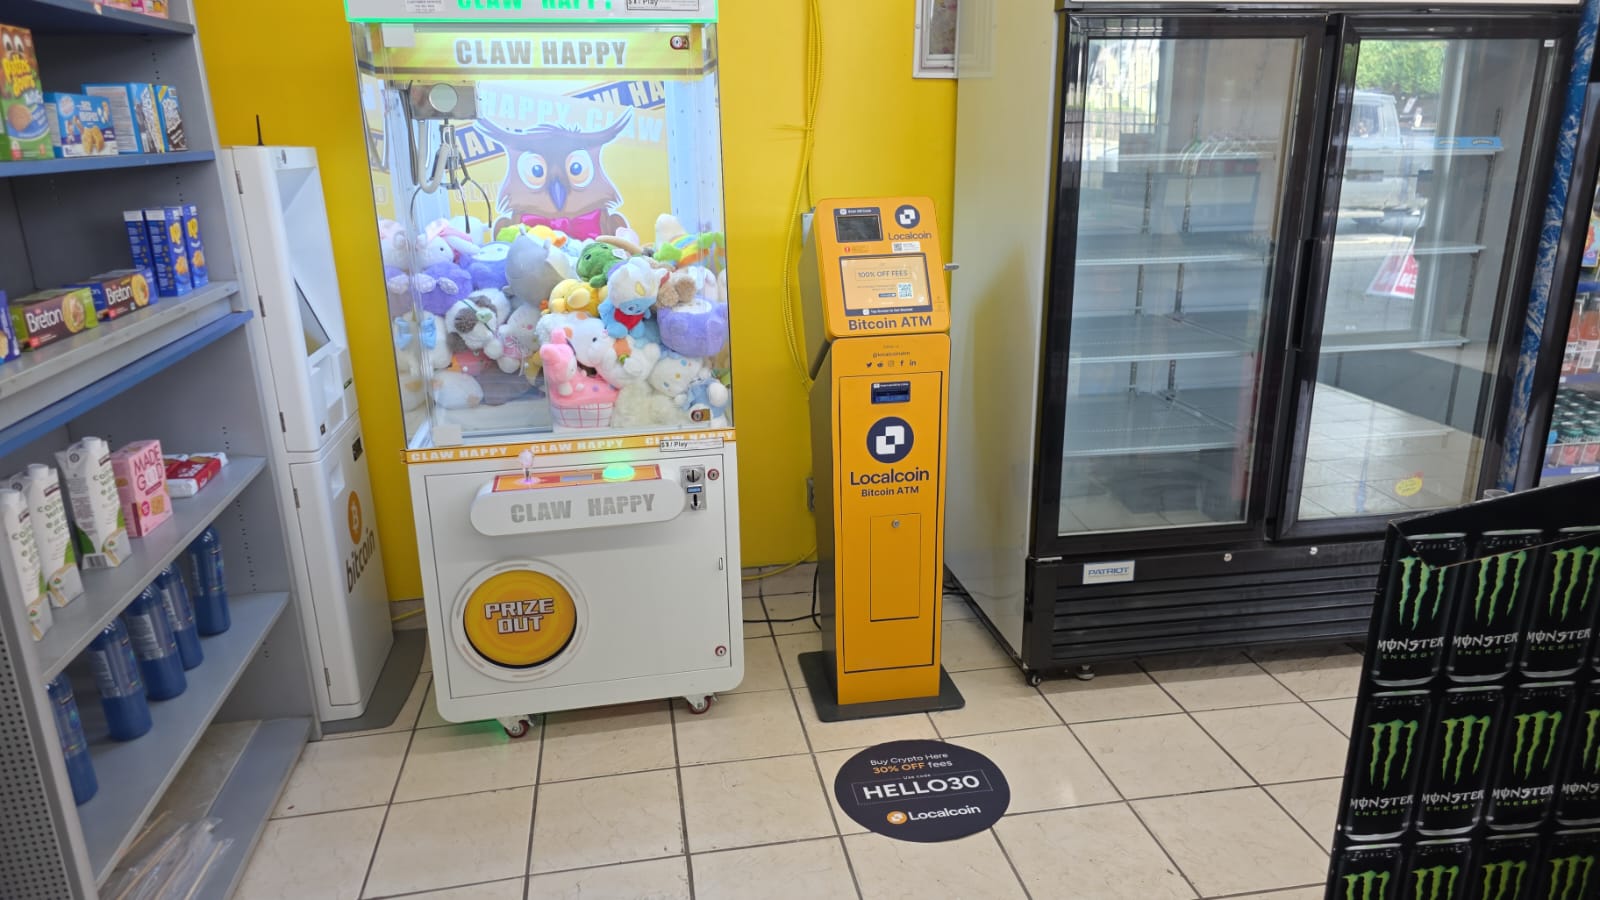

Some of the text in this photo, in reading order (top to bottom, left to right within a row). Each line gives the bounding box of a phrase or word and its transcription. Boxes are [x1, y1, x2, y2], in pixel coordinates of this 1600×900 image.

[455, 39, 627, 66] CLAW HAPPY
[888, 231, 932, 241] Localcoin
[105, 285, 133, 305] Breton
[25, 308, 64, 334] Breton
[848, 315, 932, 331] Bitcoin ATM
[530, 439, 625, 453] CLAW HAPPY
[134, 444, 160, 475] MADE
[411, 447, 508, 462] CLAW HAPPY
[850, 467, 930, 486] Localcoin
[861, 485, 919, 497] Bitcoin ATM
[510, 493, 656, 524] CLAW HAPPY
[346, 527, 376, 594] bitcoin
[1088, 567, 1129, 576] PATRIOT
[484, 598, 555, 620] PRIZE
[498, 614, 543, 635] OUT
[1452, 632, 1519, 648] MONSTER
[1526, 627, 1592, 643] MONSTER
[1377, 636, 1445, 652] MONSTER
[870, 752, 949, 766] Buy Crypto Here
[872, 759, 953, 775] 30% OFF fees
[863, 775, 980, 800] HELLO30
[1492, 784, 1555, 800] MONSTER
[1350, 794, 1415, 809] MONSTER
[1421, 789, 1485, 805] MONSTER
[908, 804, 982, 821] Localcoin
